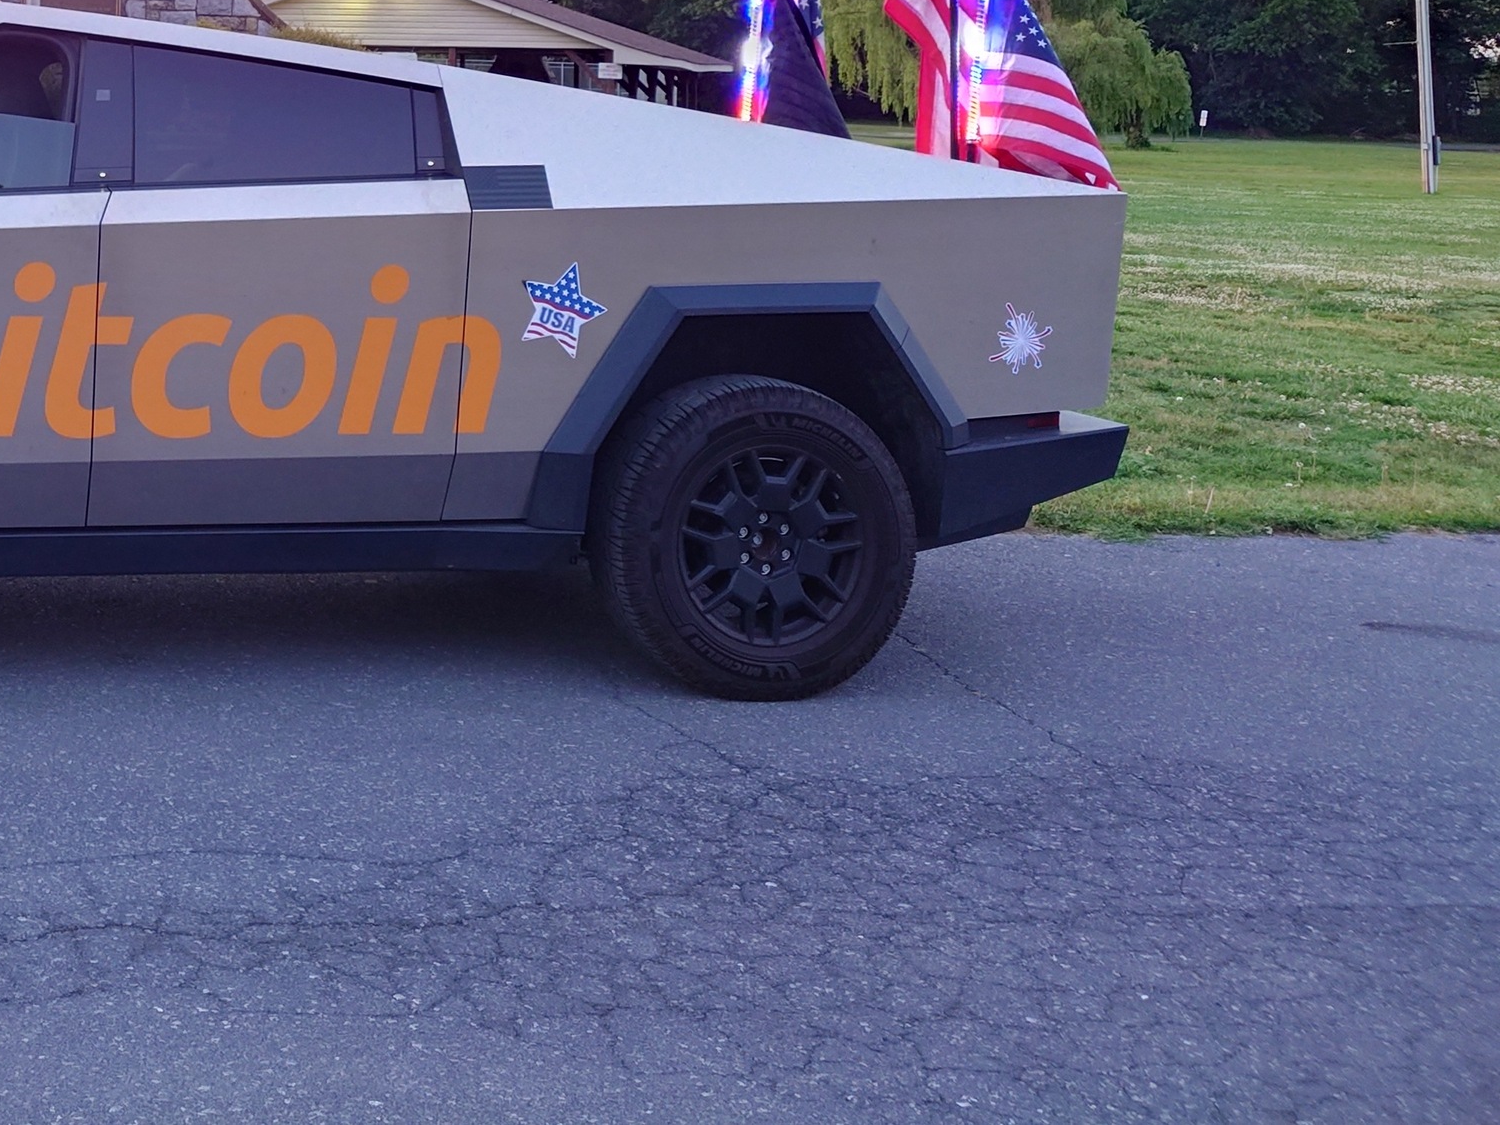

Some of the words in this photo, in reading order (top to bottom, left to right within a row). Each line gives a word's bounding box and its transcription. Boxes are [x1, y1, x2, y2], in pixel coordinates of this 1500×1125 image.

[539, 306, 576, 334] USA
[791, 416, 863, 459] MICHELIN
[689, 636, 764, 677] MICHELIN
